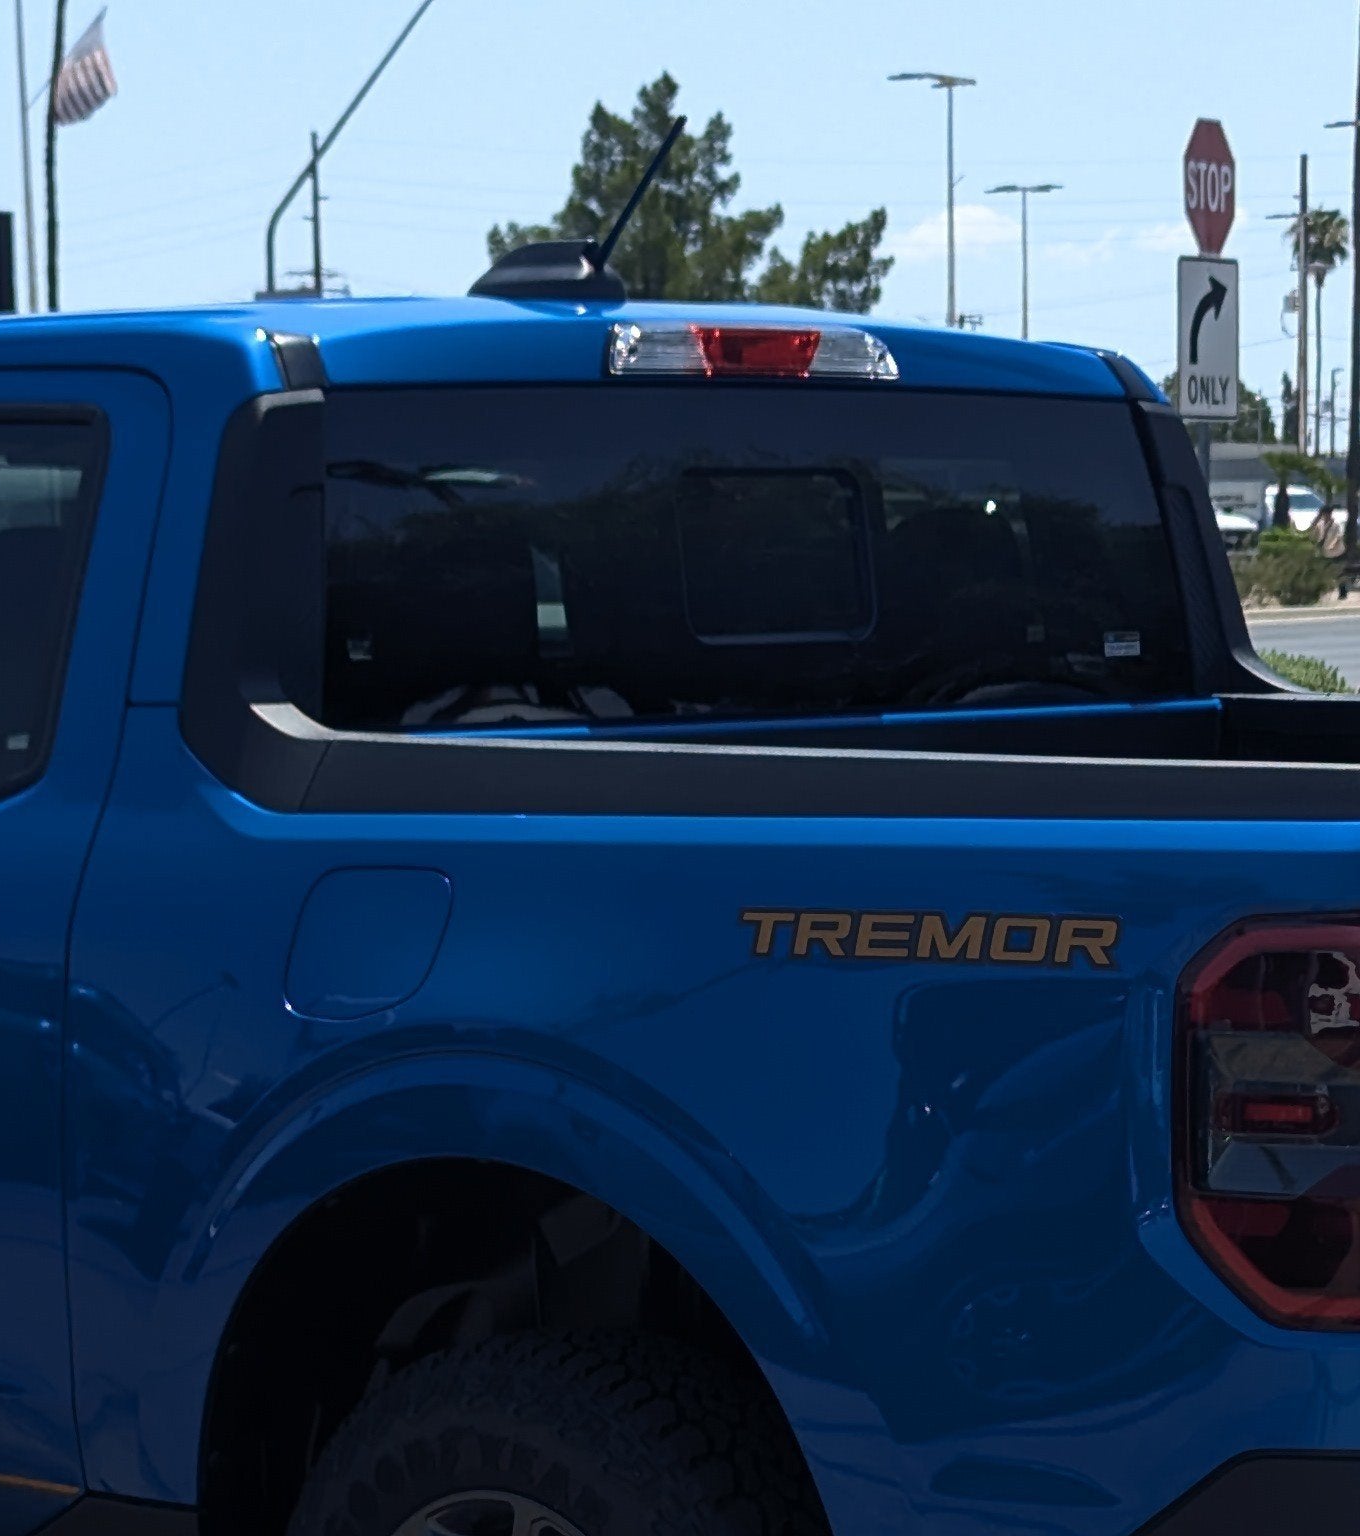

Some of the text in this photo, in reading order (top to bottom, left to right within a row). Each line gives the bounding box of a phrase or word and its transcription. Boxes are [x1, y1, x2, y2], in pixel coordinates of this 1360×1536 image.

[1188, 160, 1231, 213] STOP
[1187, 375, 1230, 406] ONLY
[740, 910, 1120, 967] TREMOR
